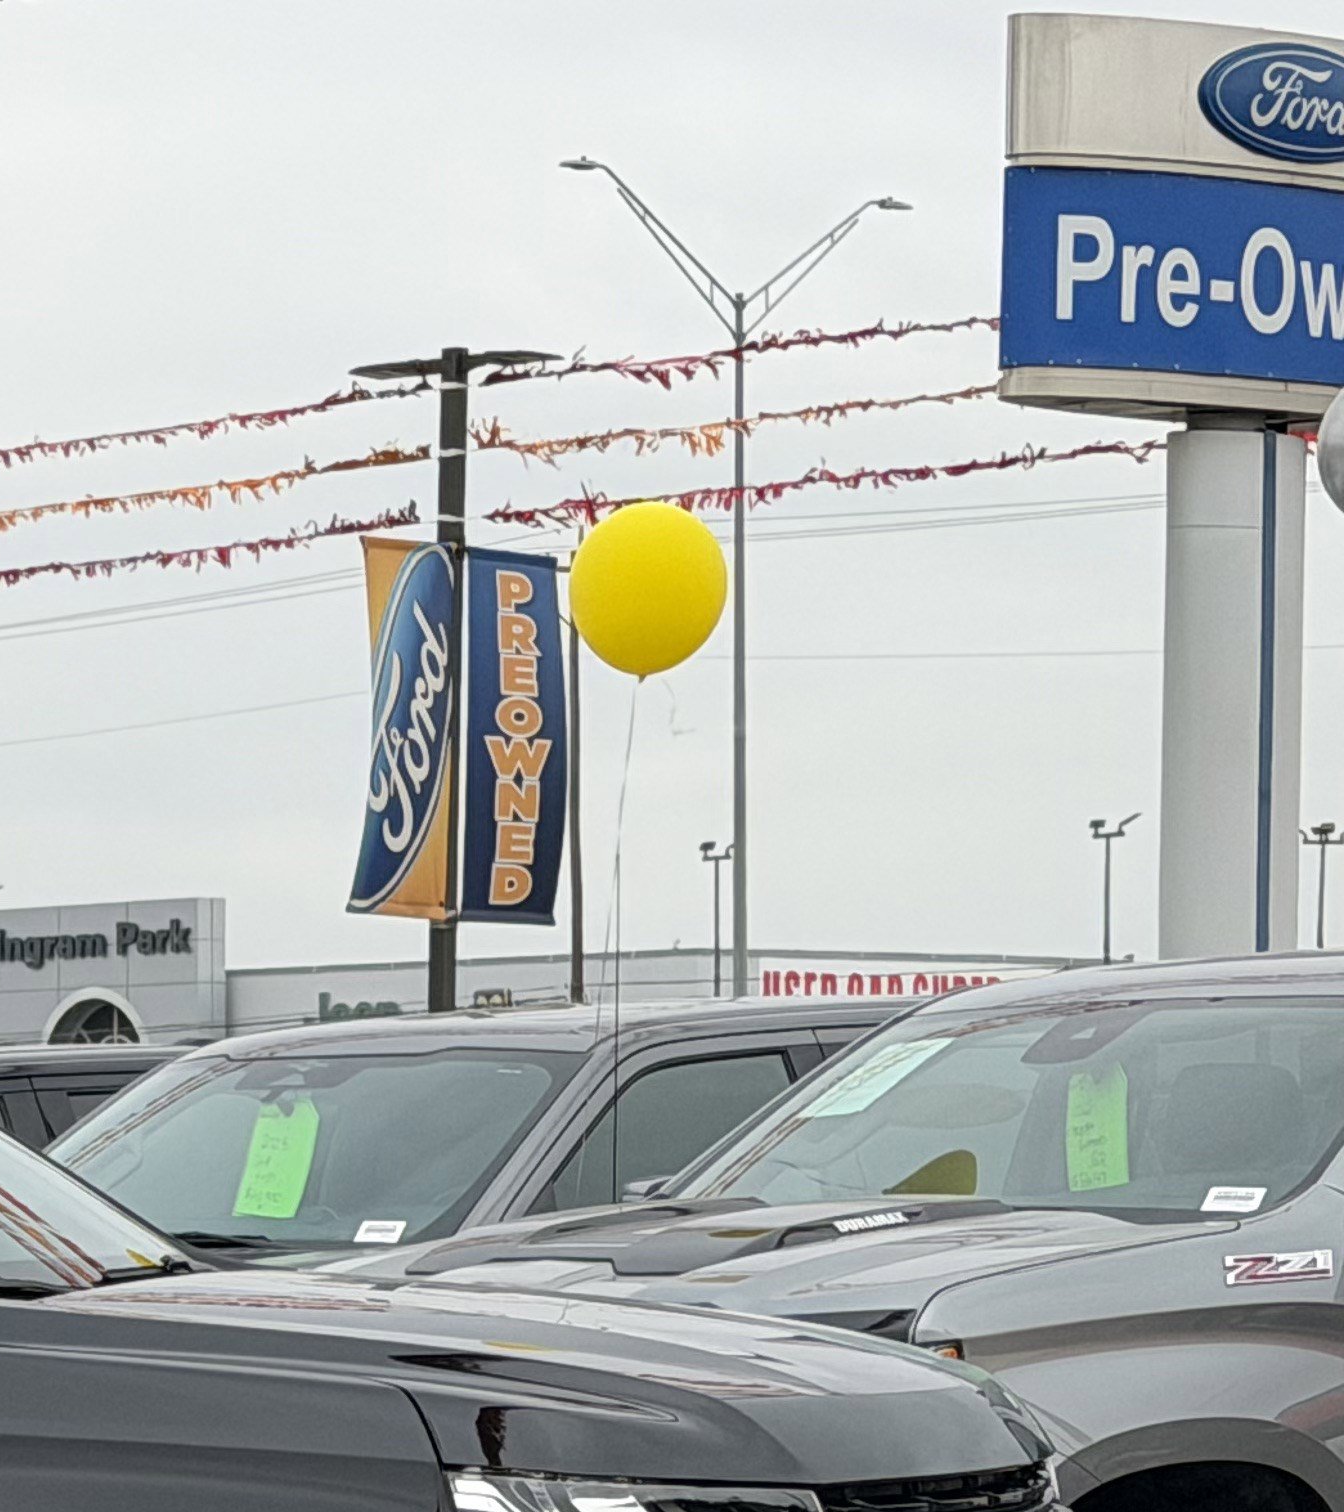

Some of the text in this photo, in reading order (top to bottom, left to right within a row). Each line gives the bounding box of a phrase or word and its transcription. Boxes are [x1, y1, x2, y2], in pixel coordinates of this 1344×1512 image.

[368, 600, 448, 853] Ford
[483, 569, 553, 906] PREOWNED
[115, 917, 193, 958] Park
[832, 1211, 910, 1234] DURAMAX
